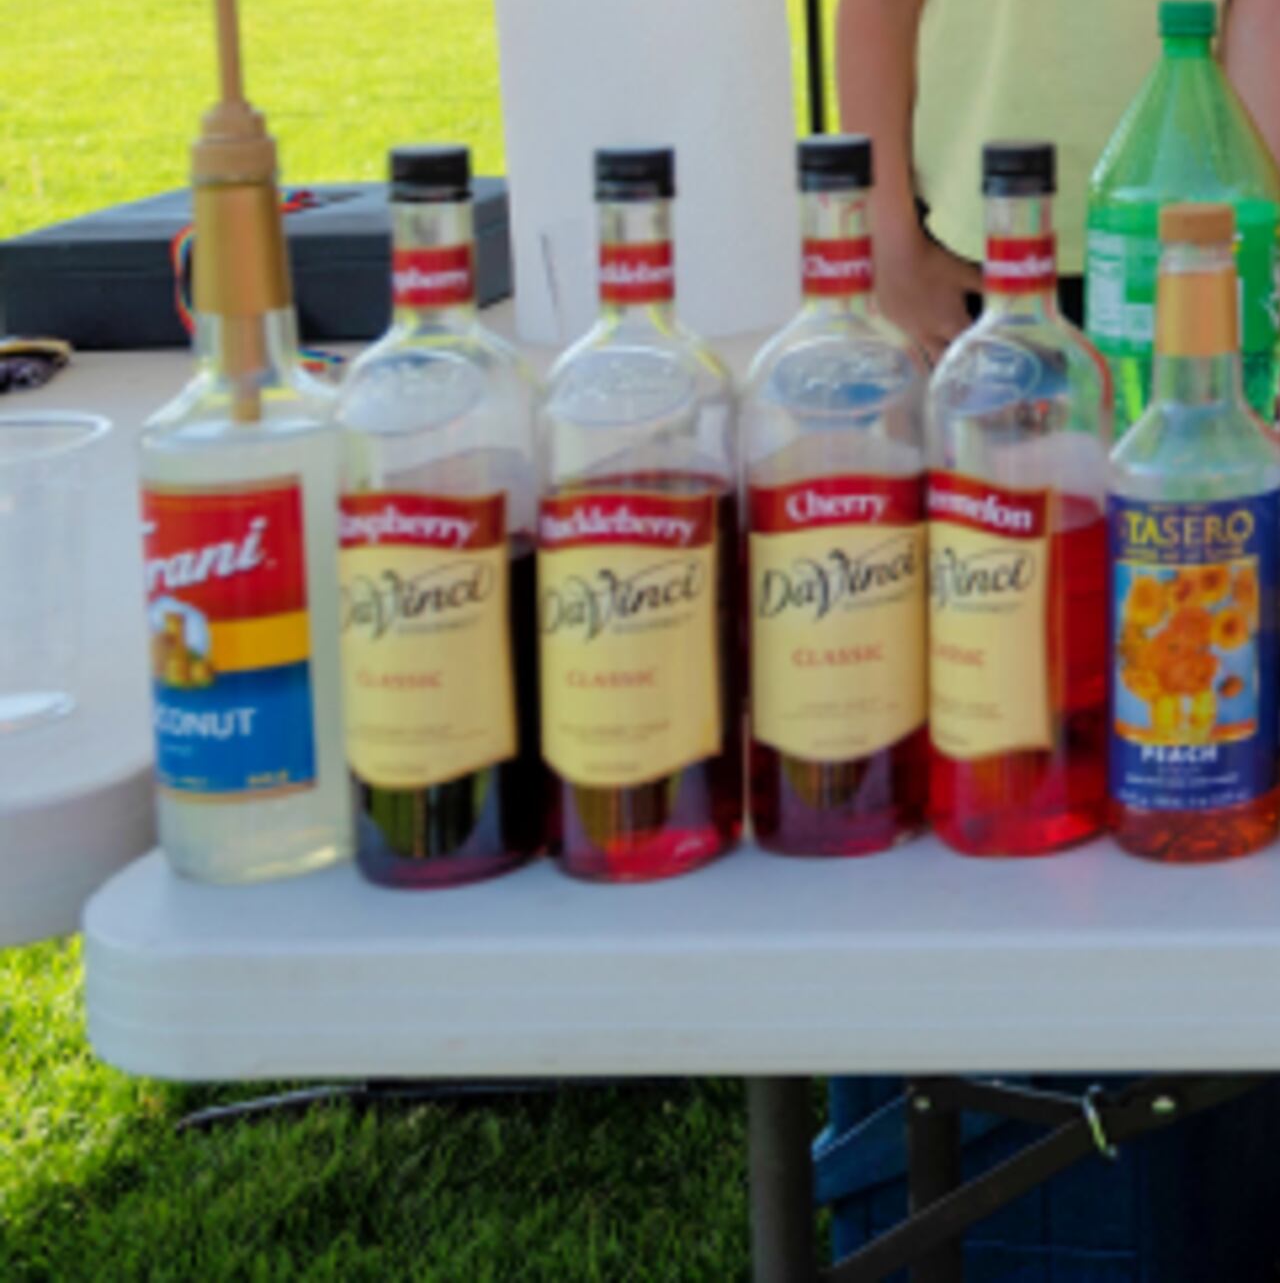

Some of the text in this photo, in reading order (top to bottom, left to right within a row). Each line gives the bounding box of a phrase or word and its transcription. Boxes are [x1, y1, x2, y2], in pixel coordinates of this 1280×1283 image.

[785, 487, 893, 525] Cherry
[1123, 509, 1254, 547] TASERO
[144, 517, 267, 591] rani
[757, 542, 917, 624] DaVinci
[1140, 744, 1219, 763] PEACH
